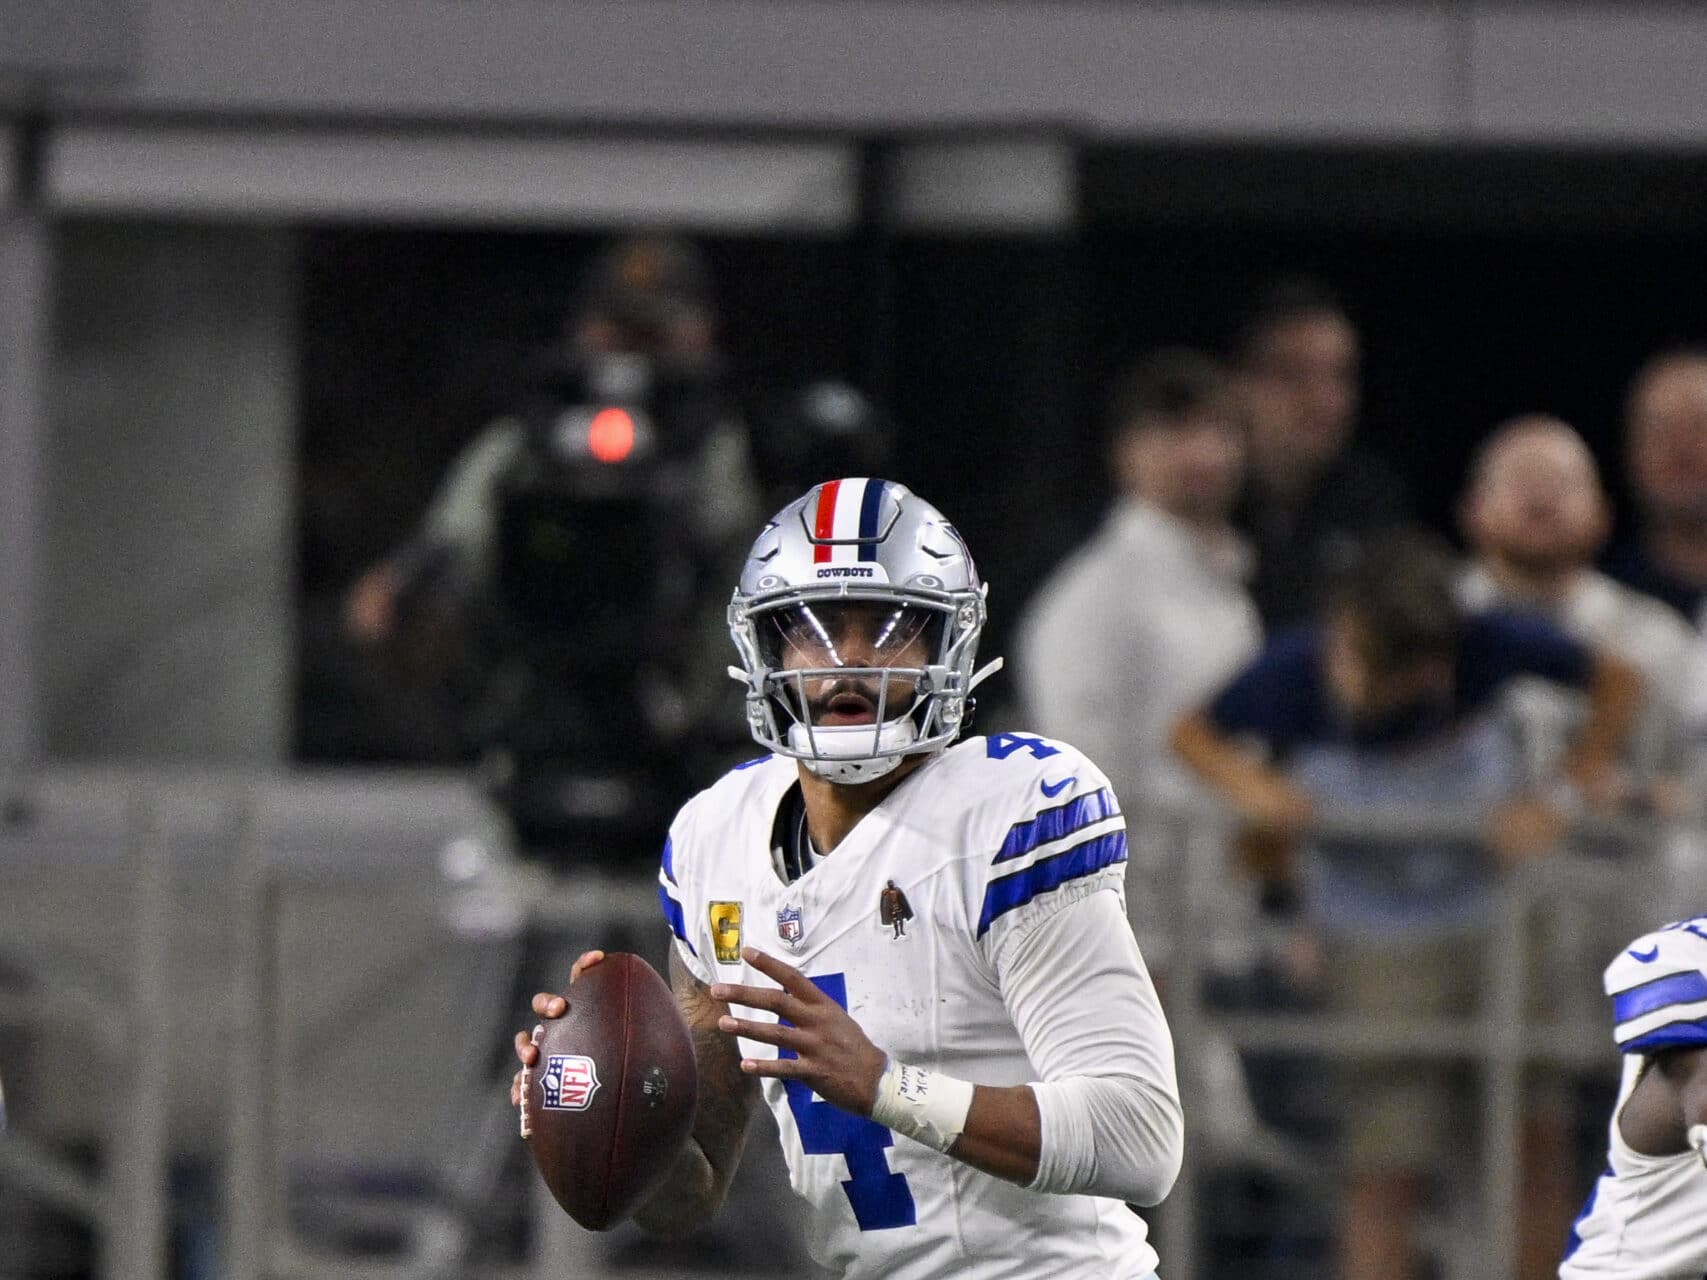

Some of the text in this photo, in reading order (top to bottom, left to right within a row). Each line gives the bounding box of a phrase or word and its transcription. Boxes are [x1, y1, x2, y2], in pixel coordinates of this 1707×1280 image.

[817, 567, 873, 578] COWBOYS
[986, 732, 1062, 760] 4
[711, 904, 740, 948] C
[780, 922, 799, 938] NFL
[561, 1063, 590, 1104] NFL
[778, 972, 916, 1231] 4
